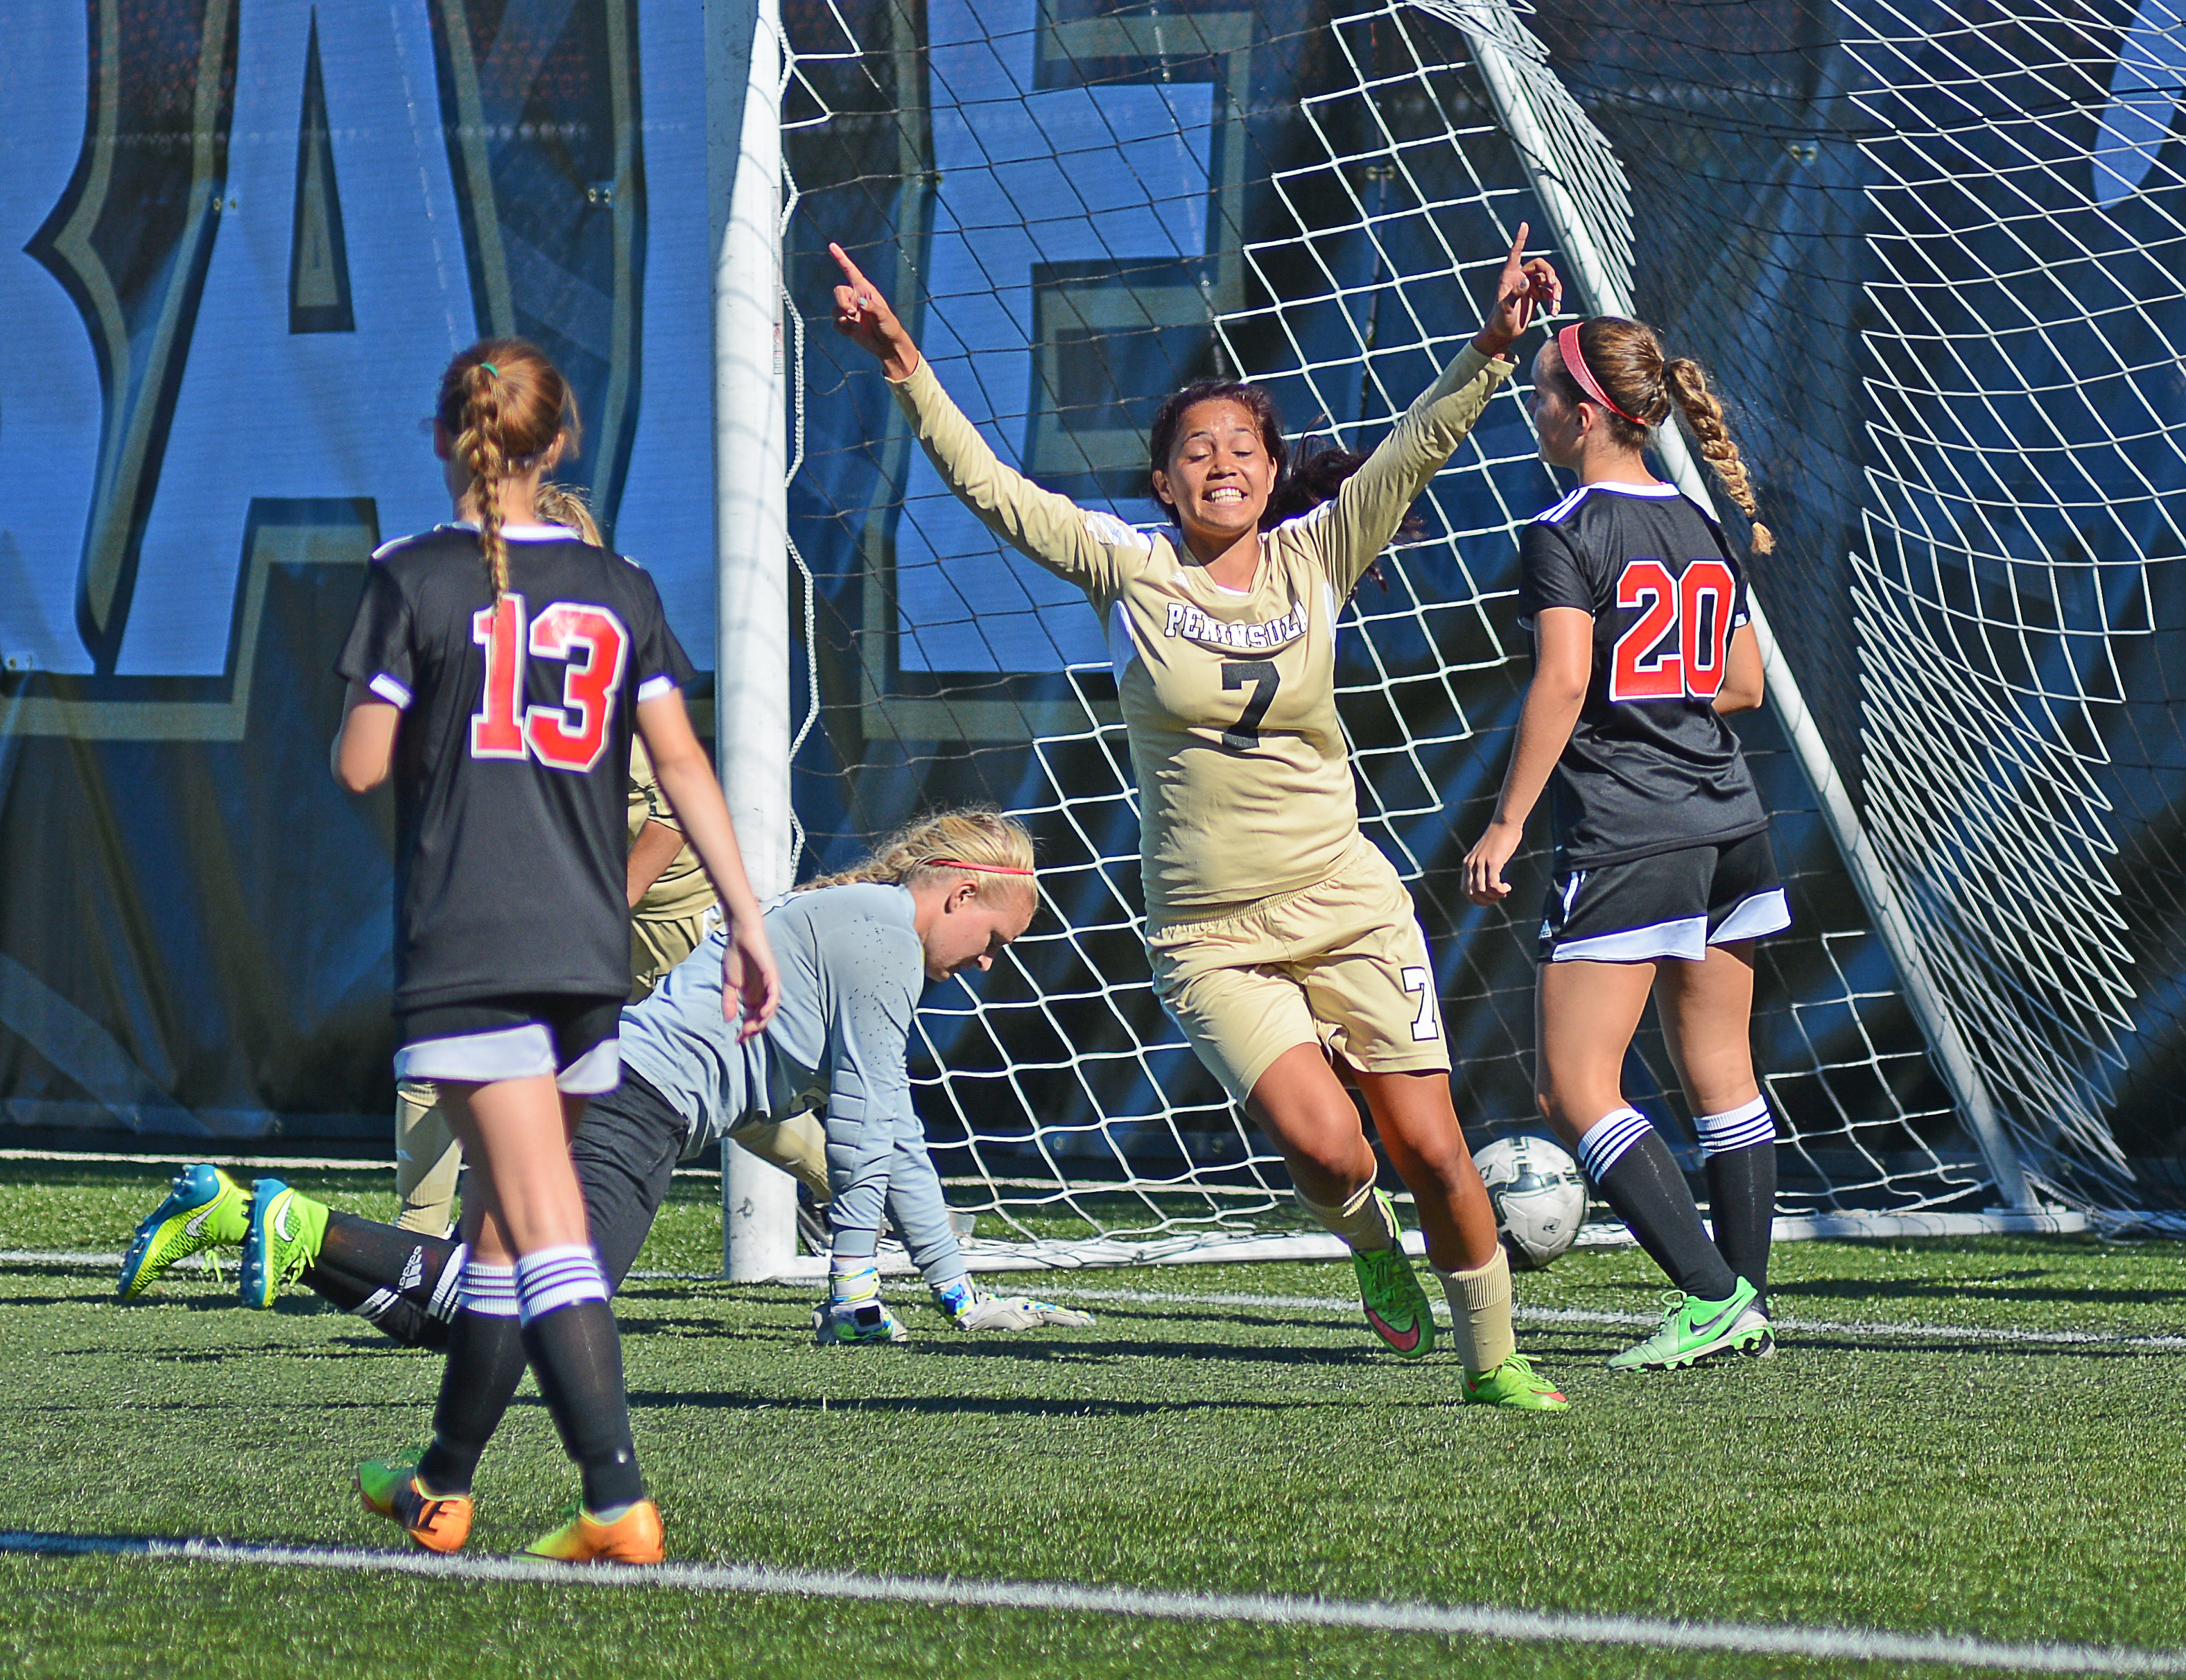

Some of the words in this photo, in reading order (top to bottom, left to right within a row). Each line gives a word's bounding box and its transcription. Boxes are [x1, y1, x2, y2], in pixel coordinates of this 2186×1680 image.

[1165, 598, 1308, 649] PENINSULA
[1608, 560, 1737, 702] 20
[471, 592, 630, 773] 13
[1221, 660, 1281, 751] 7
[1400, 966, 1440, 1042] 7
